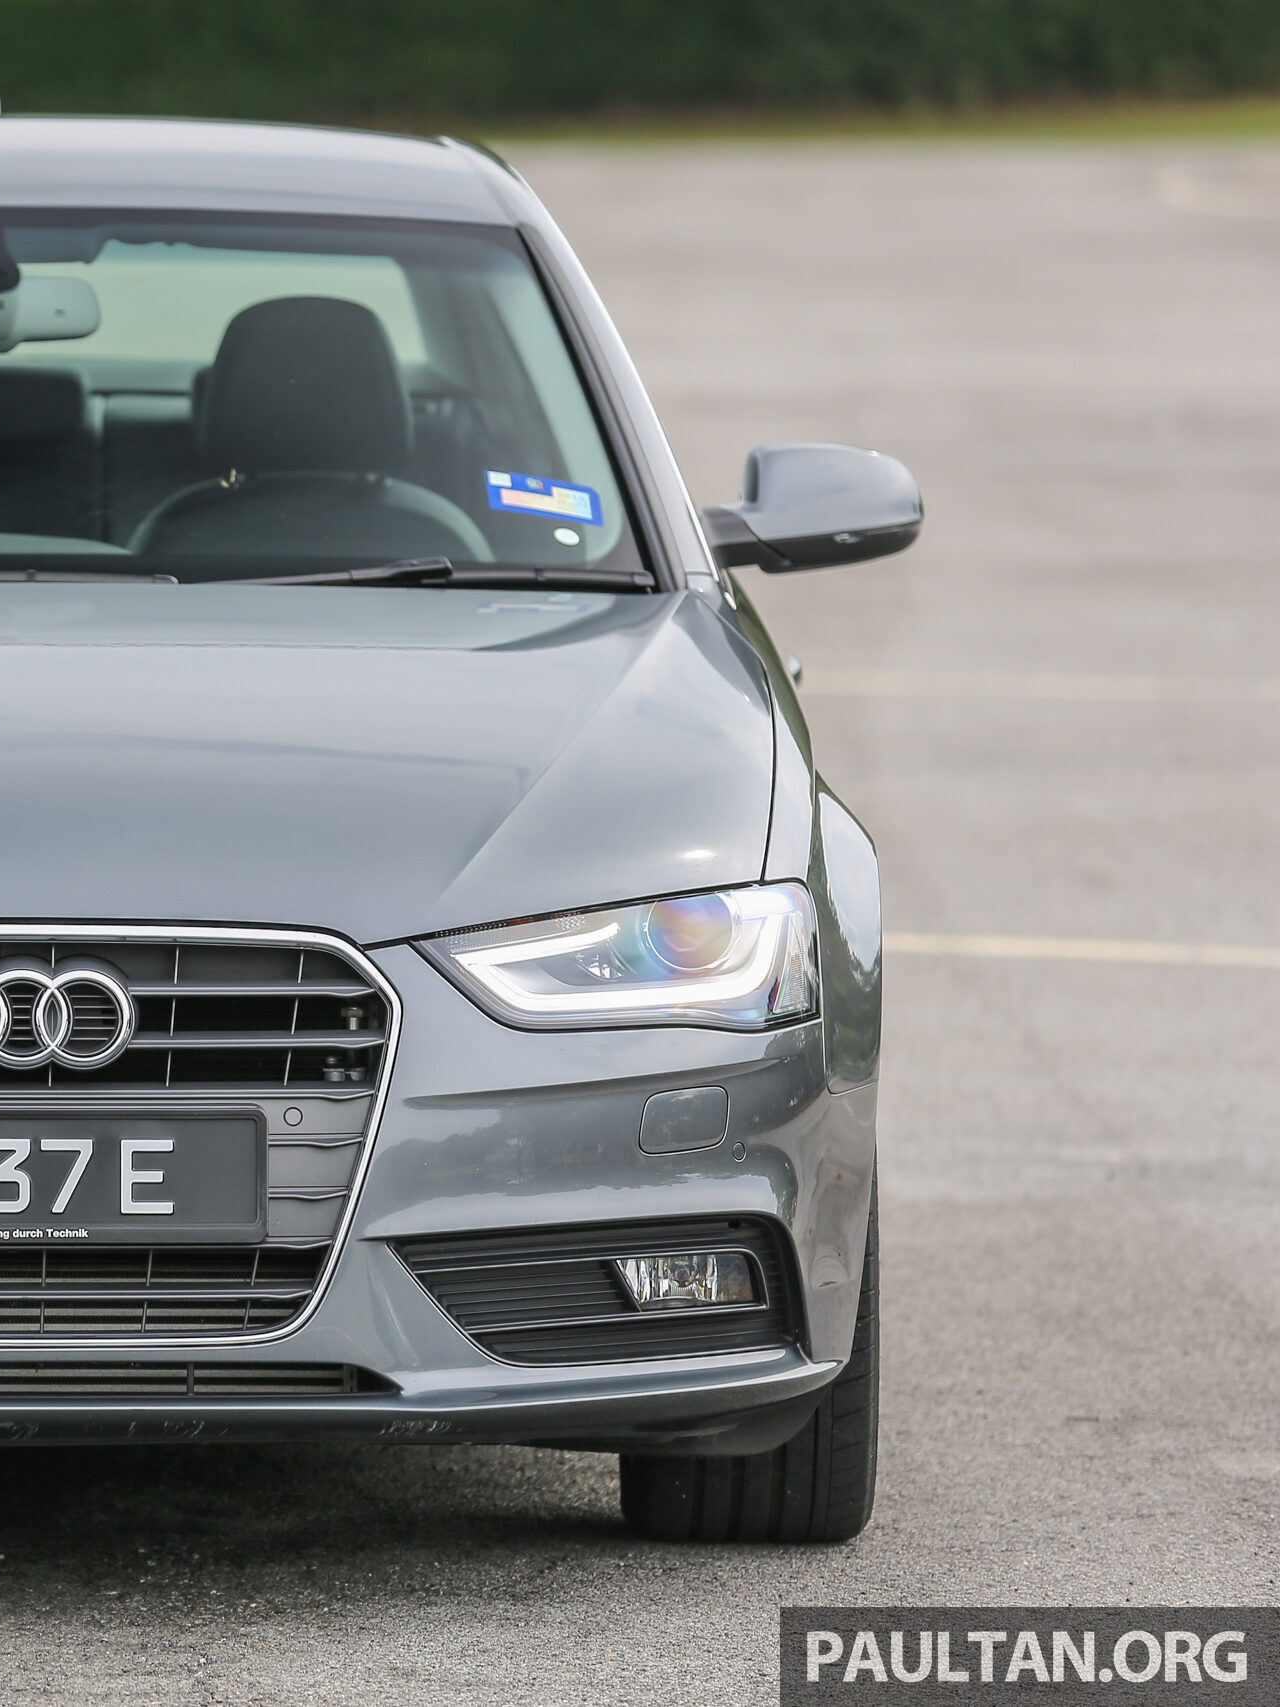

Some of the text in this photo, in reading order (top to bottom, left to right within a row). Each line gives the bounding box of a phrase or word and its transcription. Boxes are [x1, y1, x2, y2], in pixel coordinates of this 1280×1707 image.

[120, 1138, 175, 1214] E
[12, 1228, 44, 1239] durch
[46, 1228, 89, 1239] Technik
